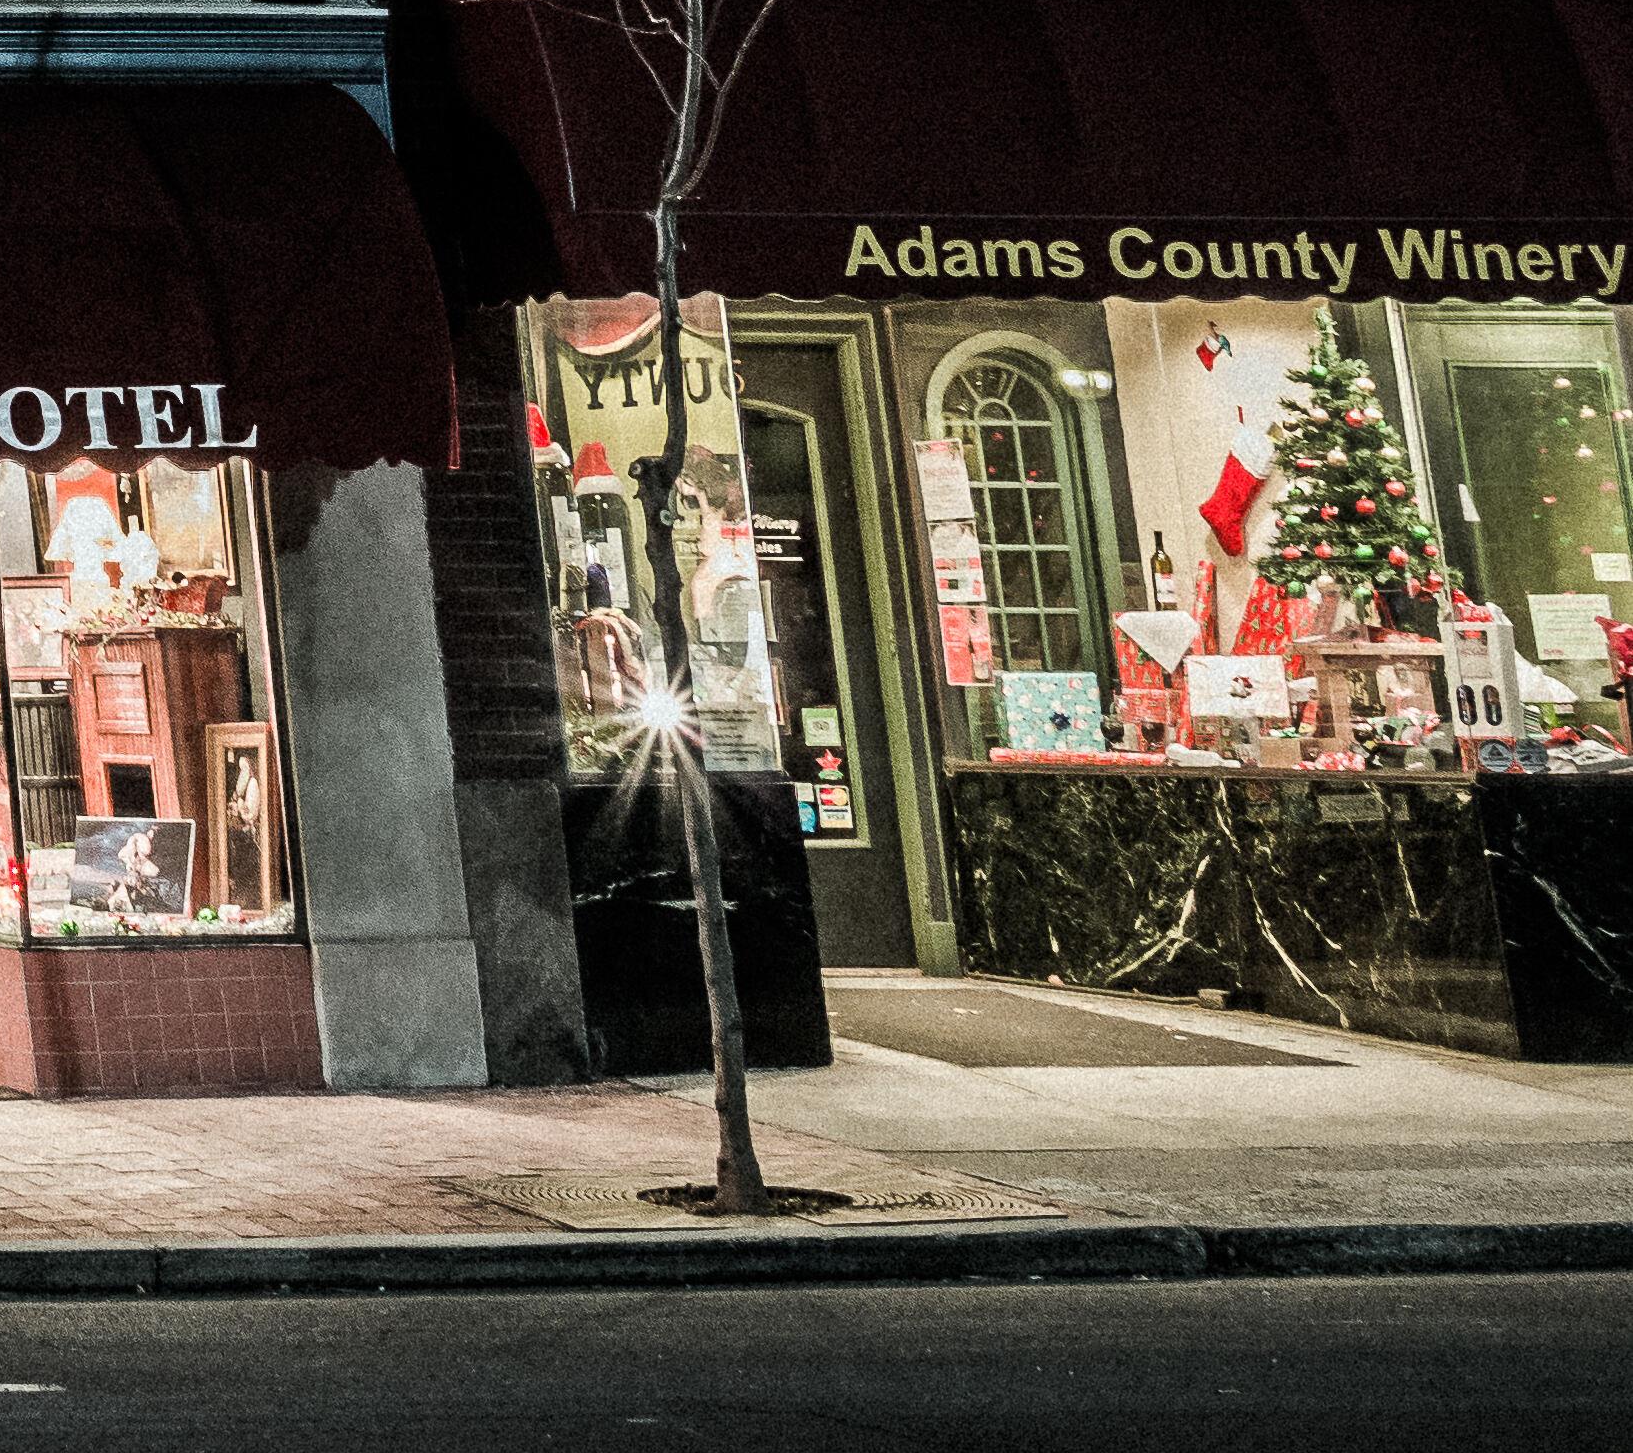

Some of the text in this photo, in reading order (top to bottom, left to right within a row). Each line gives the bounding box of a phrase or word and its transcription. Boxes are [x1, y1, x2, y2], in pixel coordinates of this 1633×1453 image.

[844, 224, 1628, 296] Adams County Winery
[754, 540, 783, 554] ales
